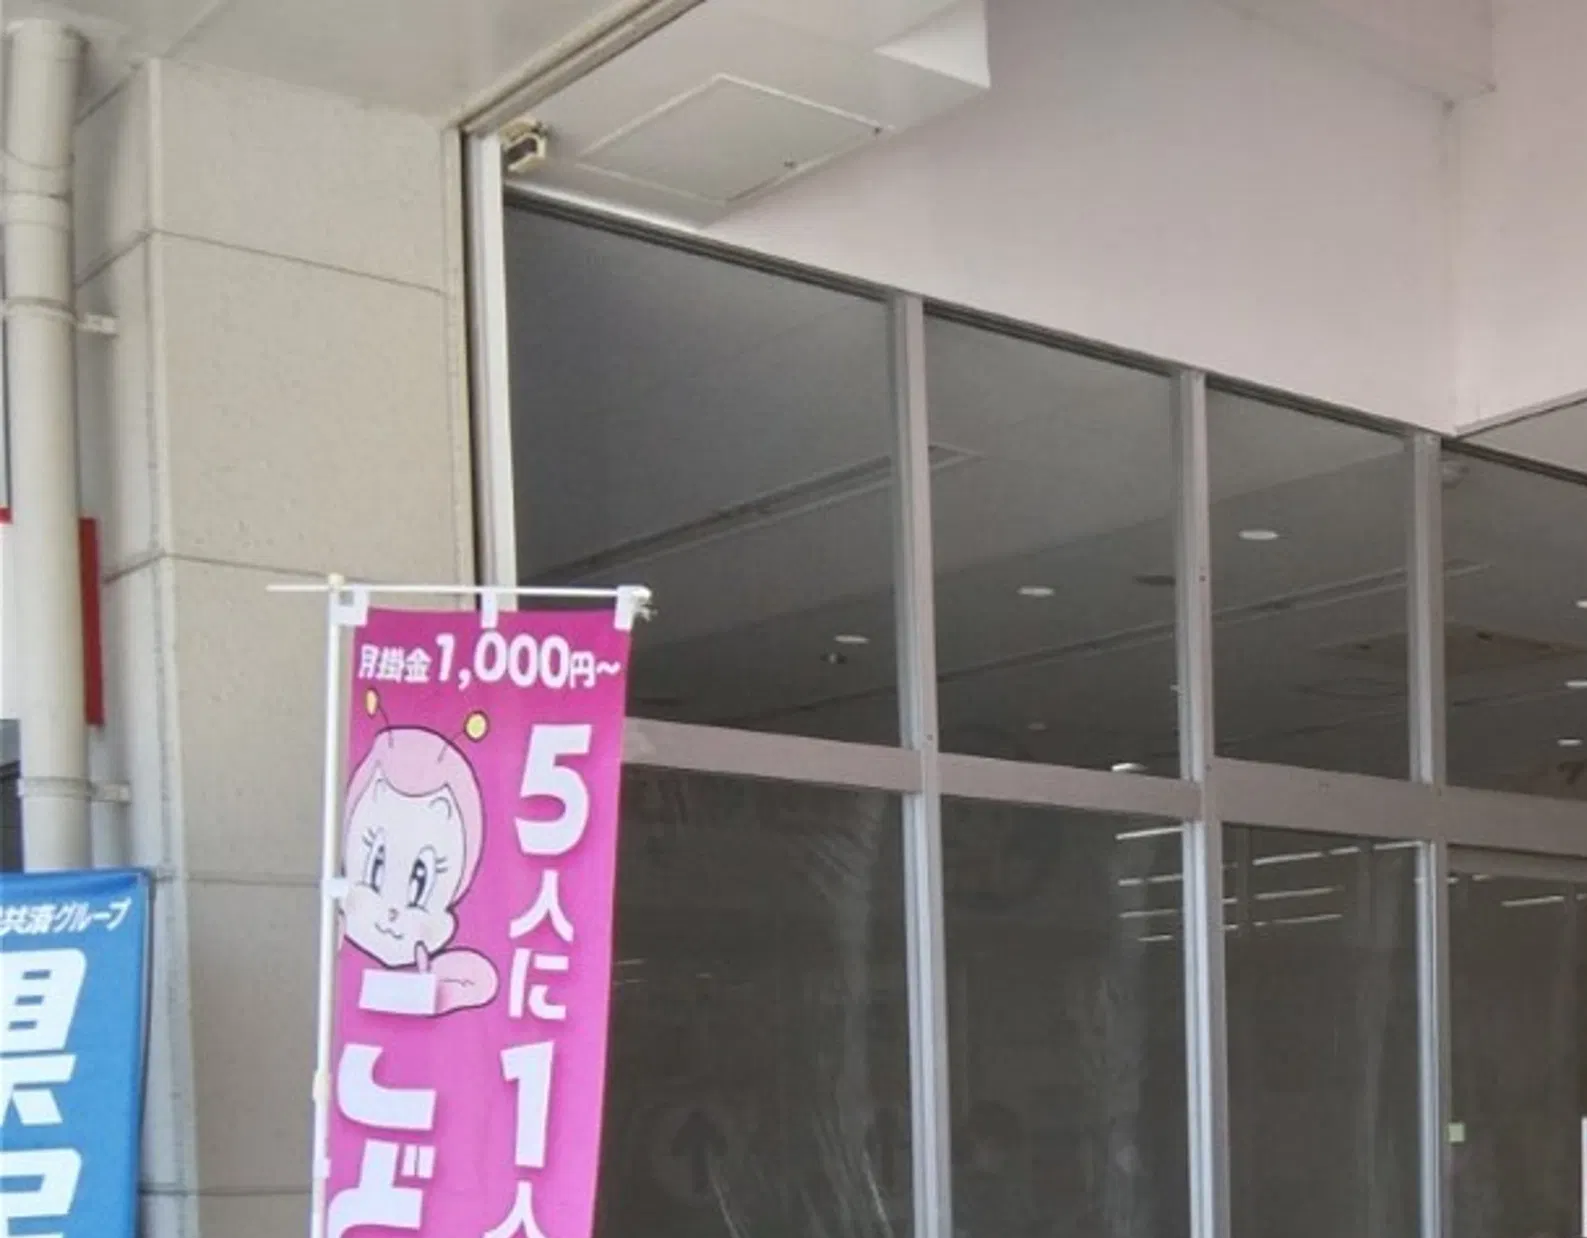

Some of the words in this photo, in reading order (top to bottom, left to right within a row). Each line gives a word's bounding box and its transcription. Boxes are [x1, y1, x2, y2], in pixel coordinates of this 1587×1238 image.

[0, 896, 132, 936] 共済グループ
